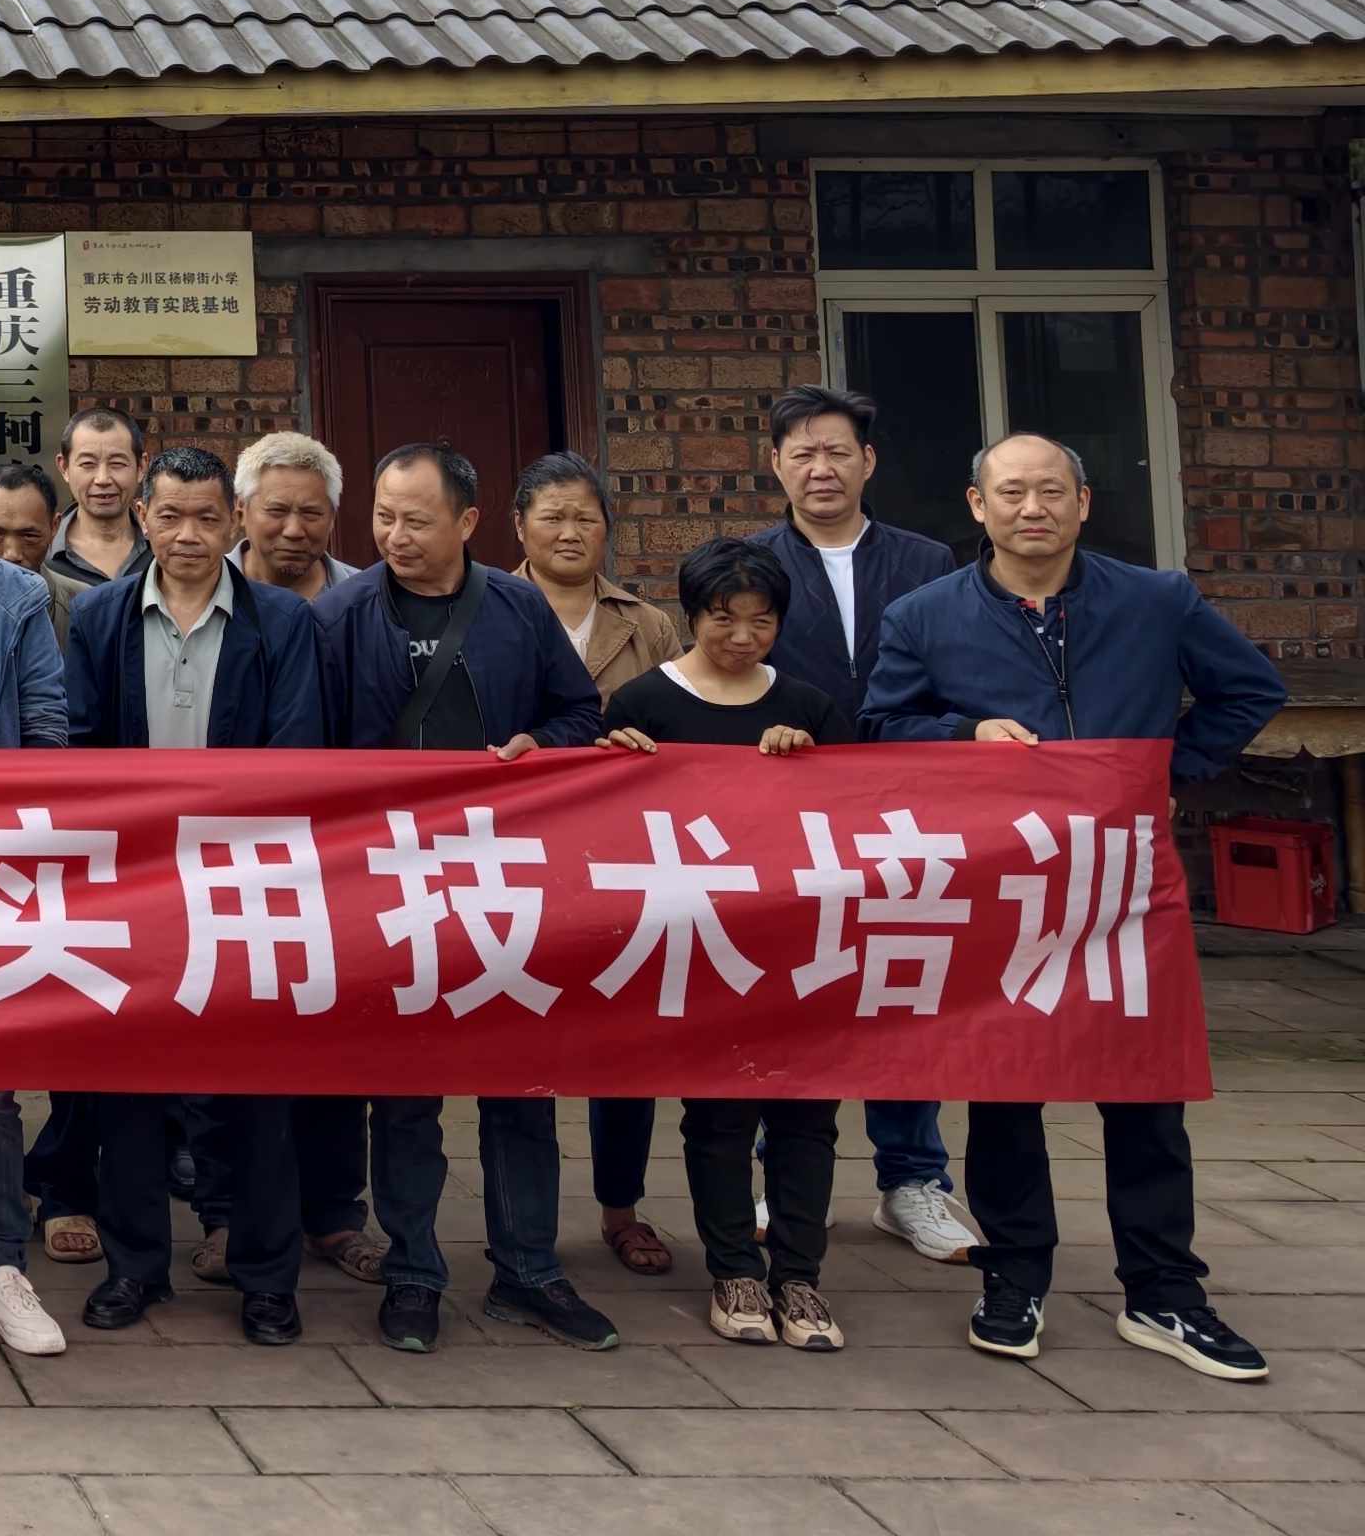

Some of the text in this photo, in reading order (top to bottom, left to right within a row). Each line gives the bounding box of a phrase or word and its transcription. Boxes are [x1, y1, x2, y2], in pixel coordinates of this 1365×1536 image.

[83, 271, 239, 286] 重庆市合川区杨柳街小学
[84, 296, 239, 314] 劳动教育实践基地
